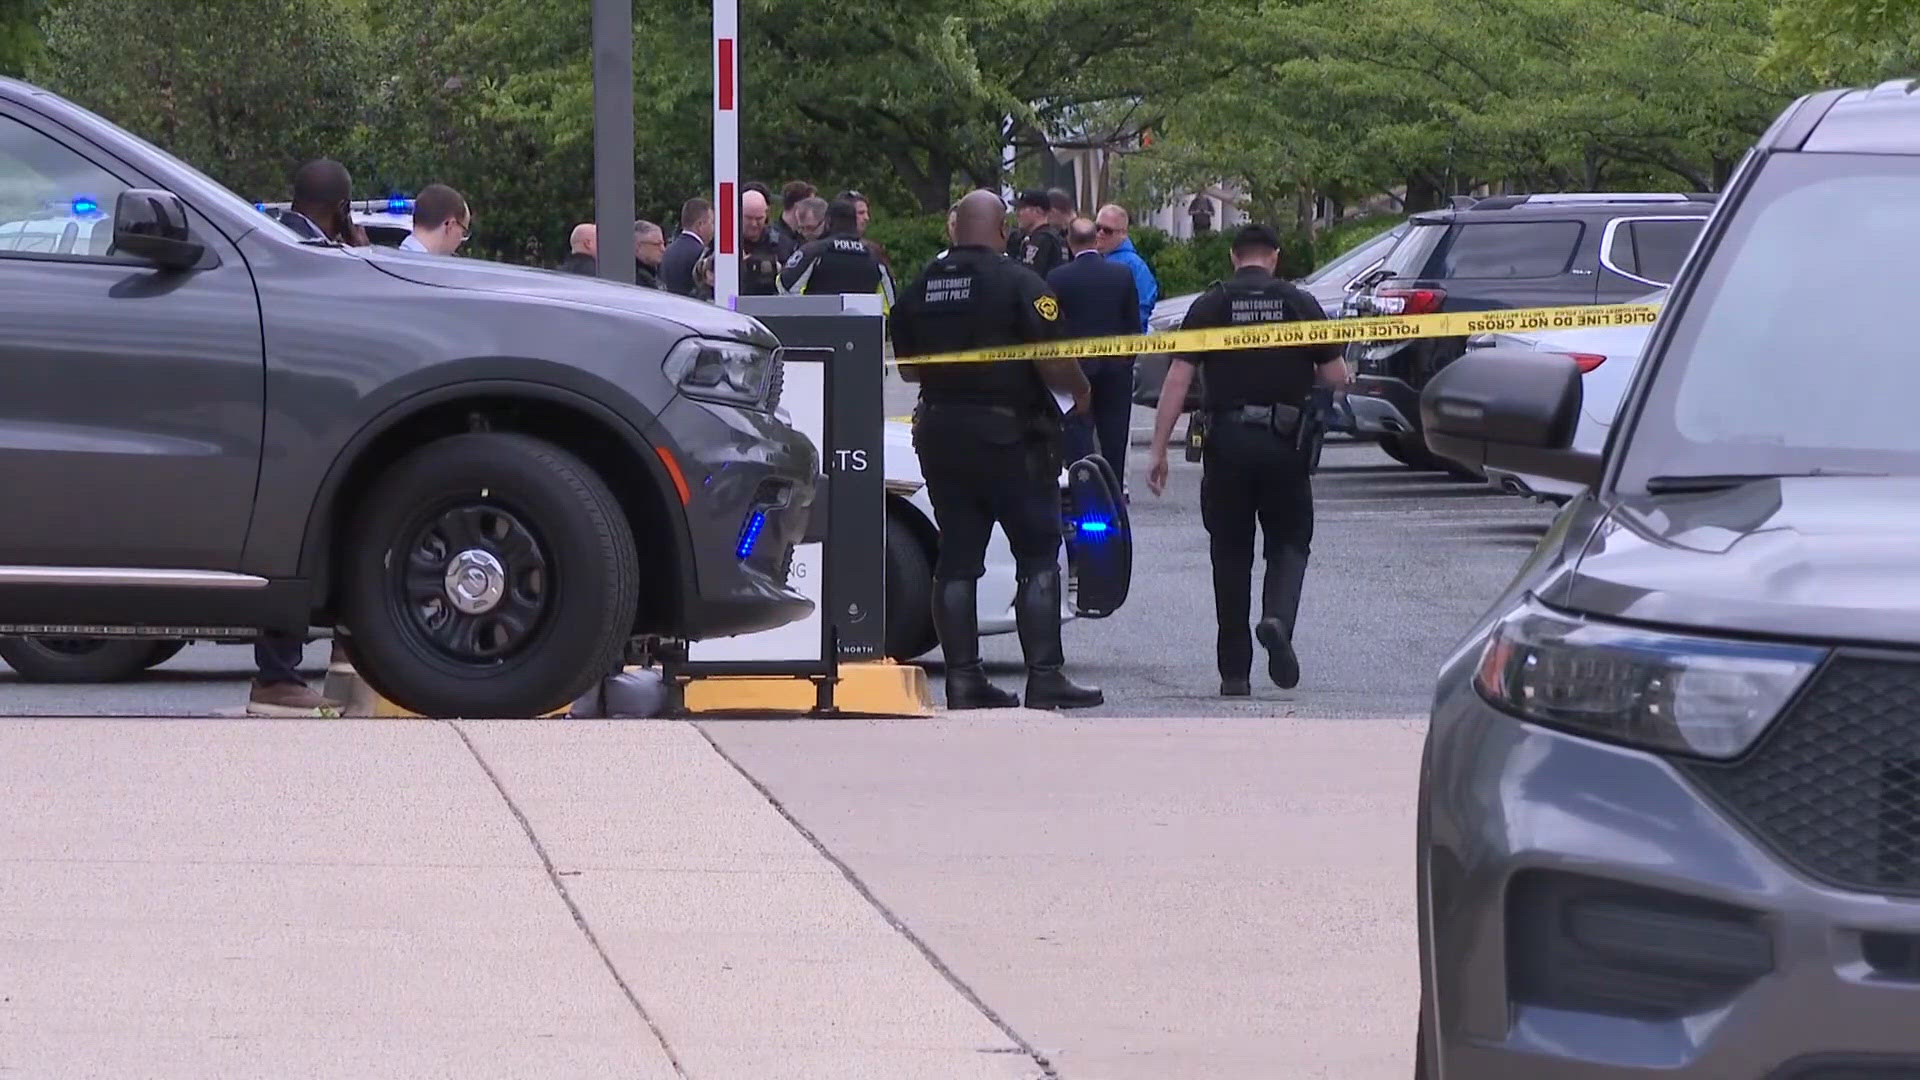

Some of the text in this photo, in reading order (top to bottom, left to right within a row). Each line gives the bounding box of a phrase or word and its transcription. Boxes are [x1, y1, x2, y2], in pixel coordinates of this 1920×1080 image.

[834, 239, 865, 252] POLICE
[926, 277, 972, 291] MONTGOMERY
[925, 289, 971, 303] COUNTY POLICE
[1231, 299, 1283, 310] MONTGOMERY
[1231, 310, 1283, 321] COUNTY POLICE
[1468, 313, 1657, 331] OLICE LINE DO NOT CROSS
[1223, 324, 1420, 346] POLICE LINE DO NOT CROSS
[1088, 343, 1121, 354] LINE
[1126, 339, 1176, 352] POLICE
